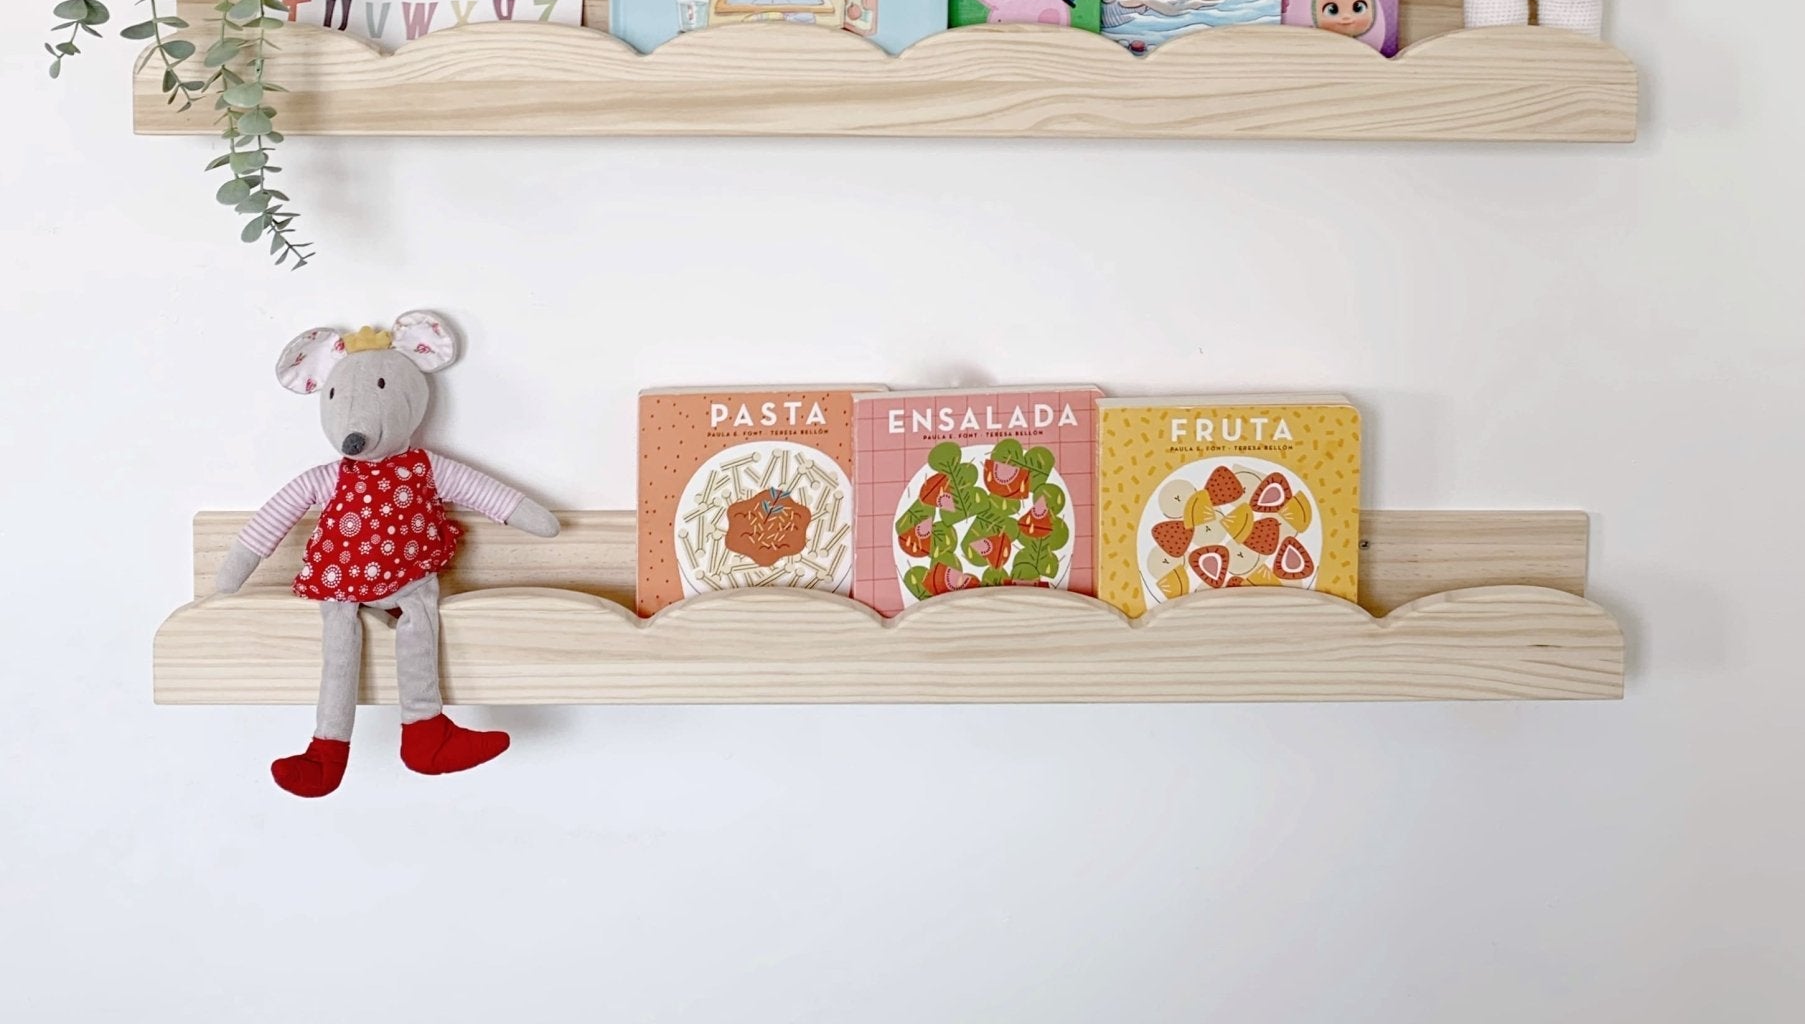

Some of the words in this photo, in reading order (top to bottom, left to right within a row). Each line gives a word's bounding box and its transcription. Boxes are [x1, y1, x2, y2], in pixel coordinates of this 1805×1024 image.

[365, 2, 392, 39] V
[401, 1, 438, 40] W
[710, 401, 826, 428] PASTA
[889, 403, 1078, 433] ENSALADA
[1171, 418, 1293, 442] FRUTA
